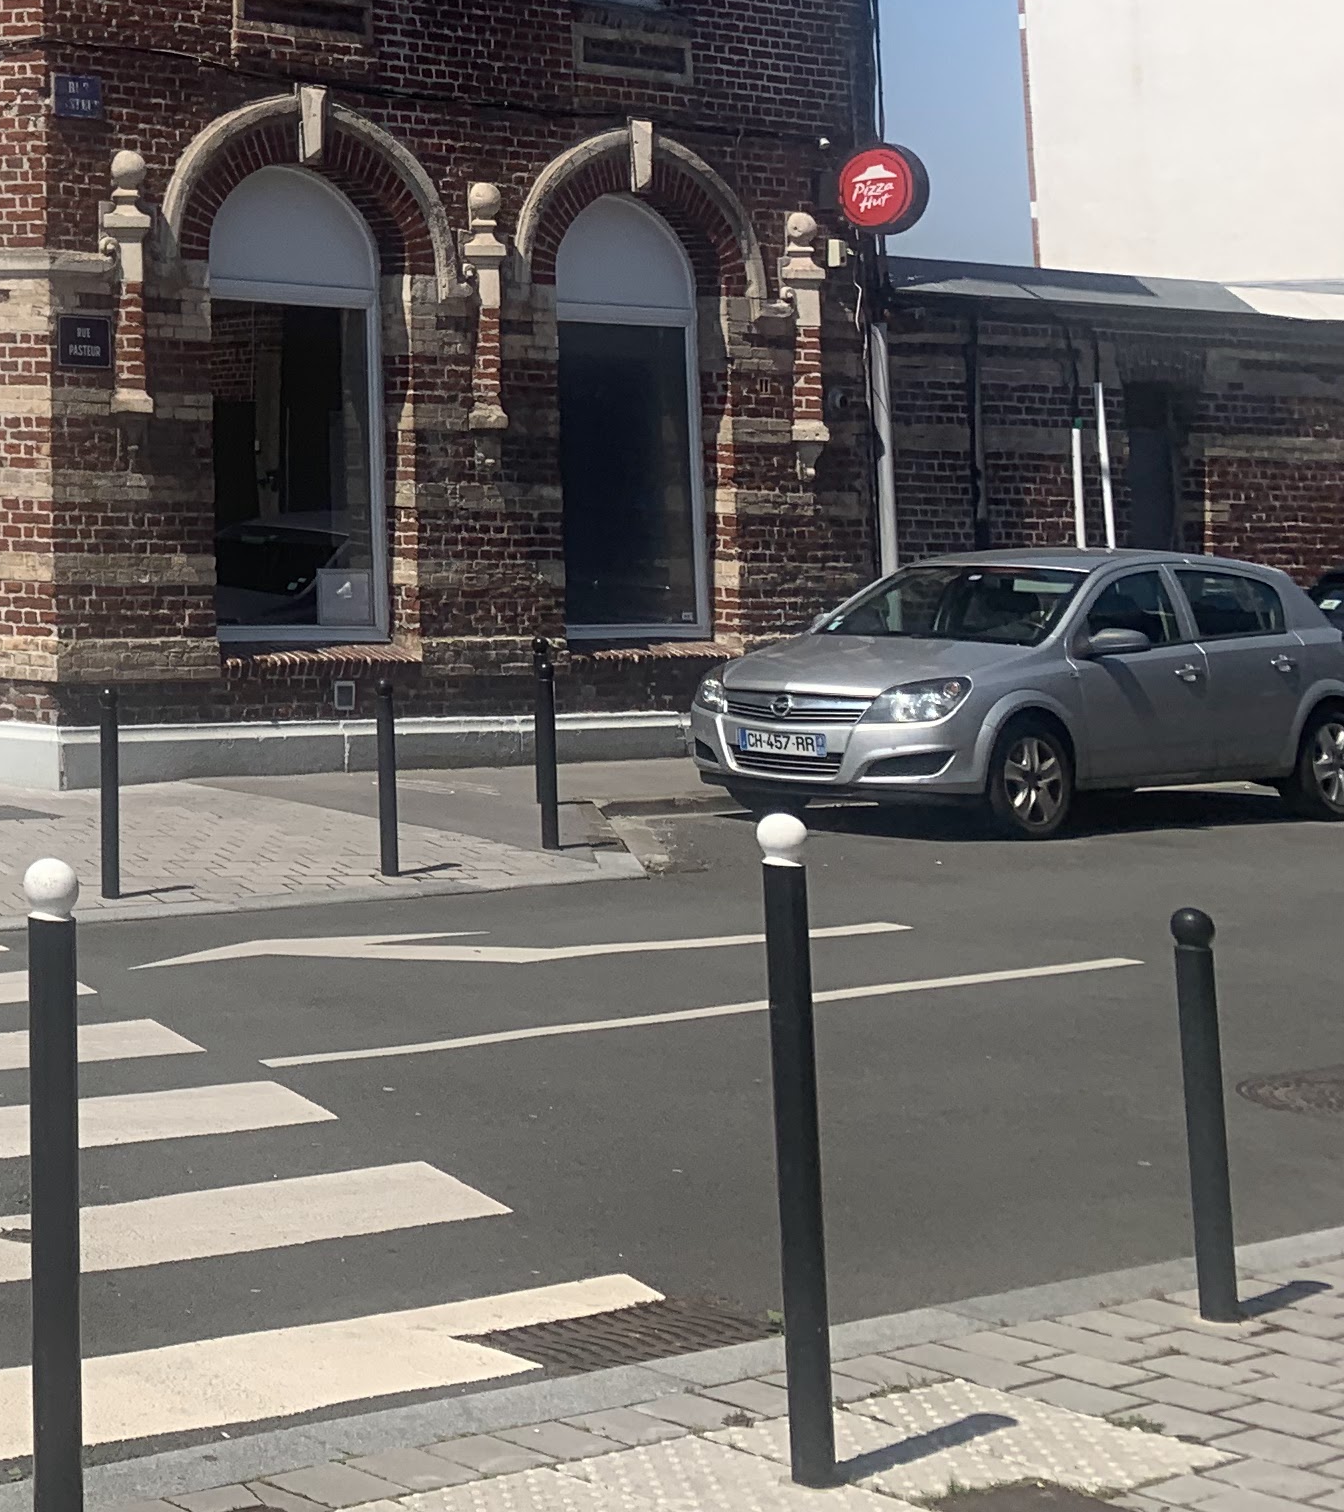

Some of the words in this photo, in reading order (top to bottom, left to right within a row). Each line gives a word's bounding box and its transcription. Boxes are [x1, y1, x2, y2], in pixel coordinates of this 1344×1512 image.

[852, 180, 894, 202] Pizza
[859, 194, 892, 213] Hut
[76, 327, 91, 338] RUE
[69, 344, 101, 357] PASTEUR
[747, 732, 816, 753] CH-457-RR
